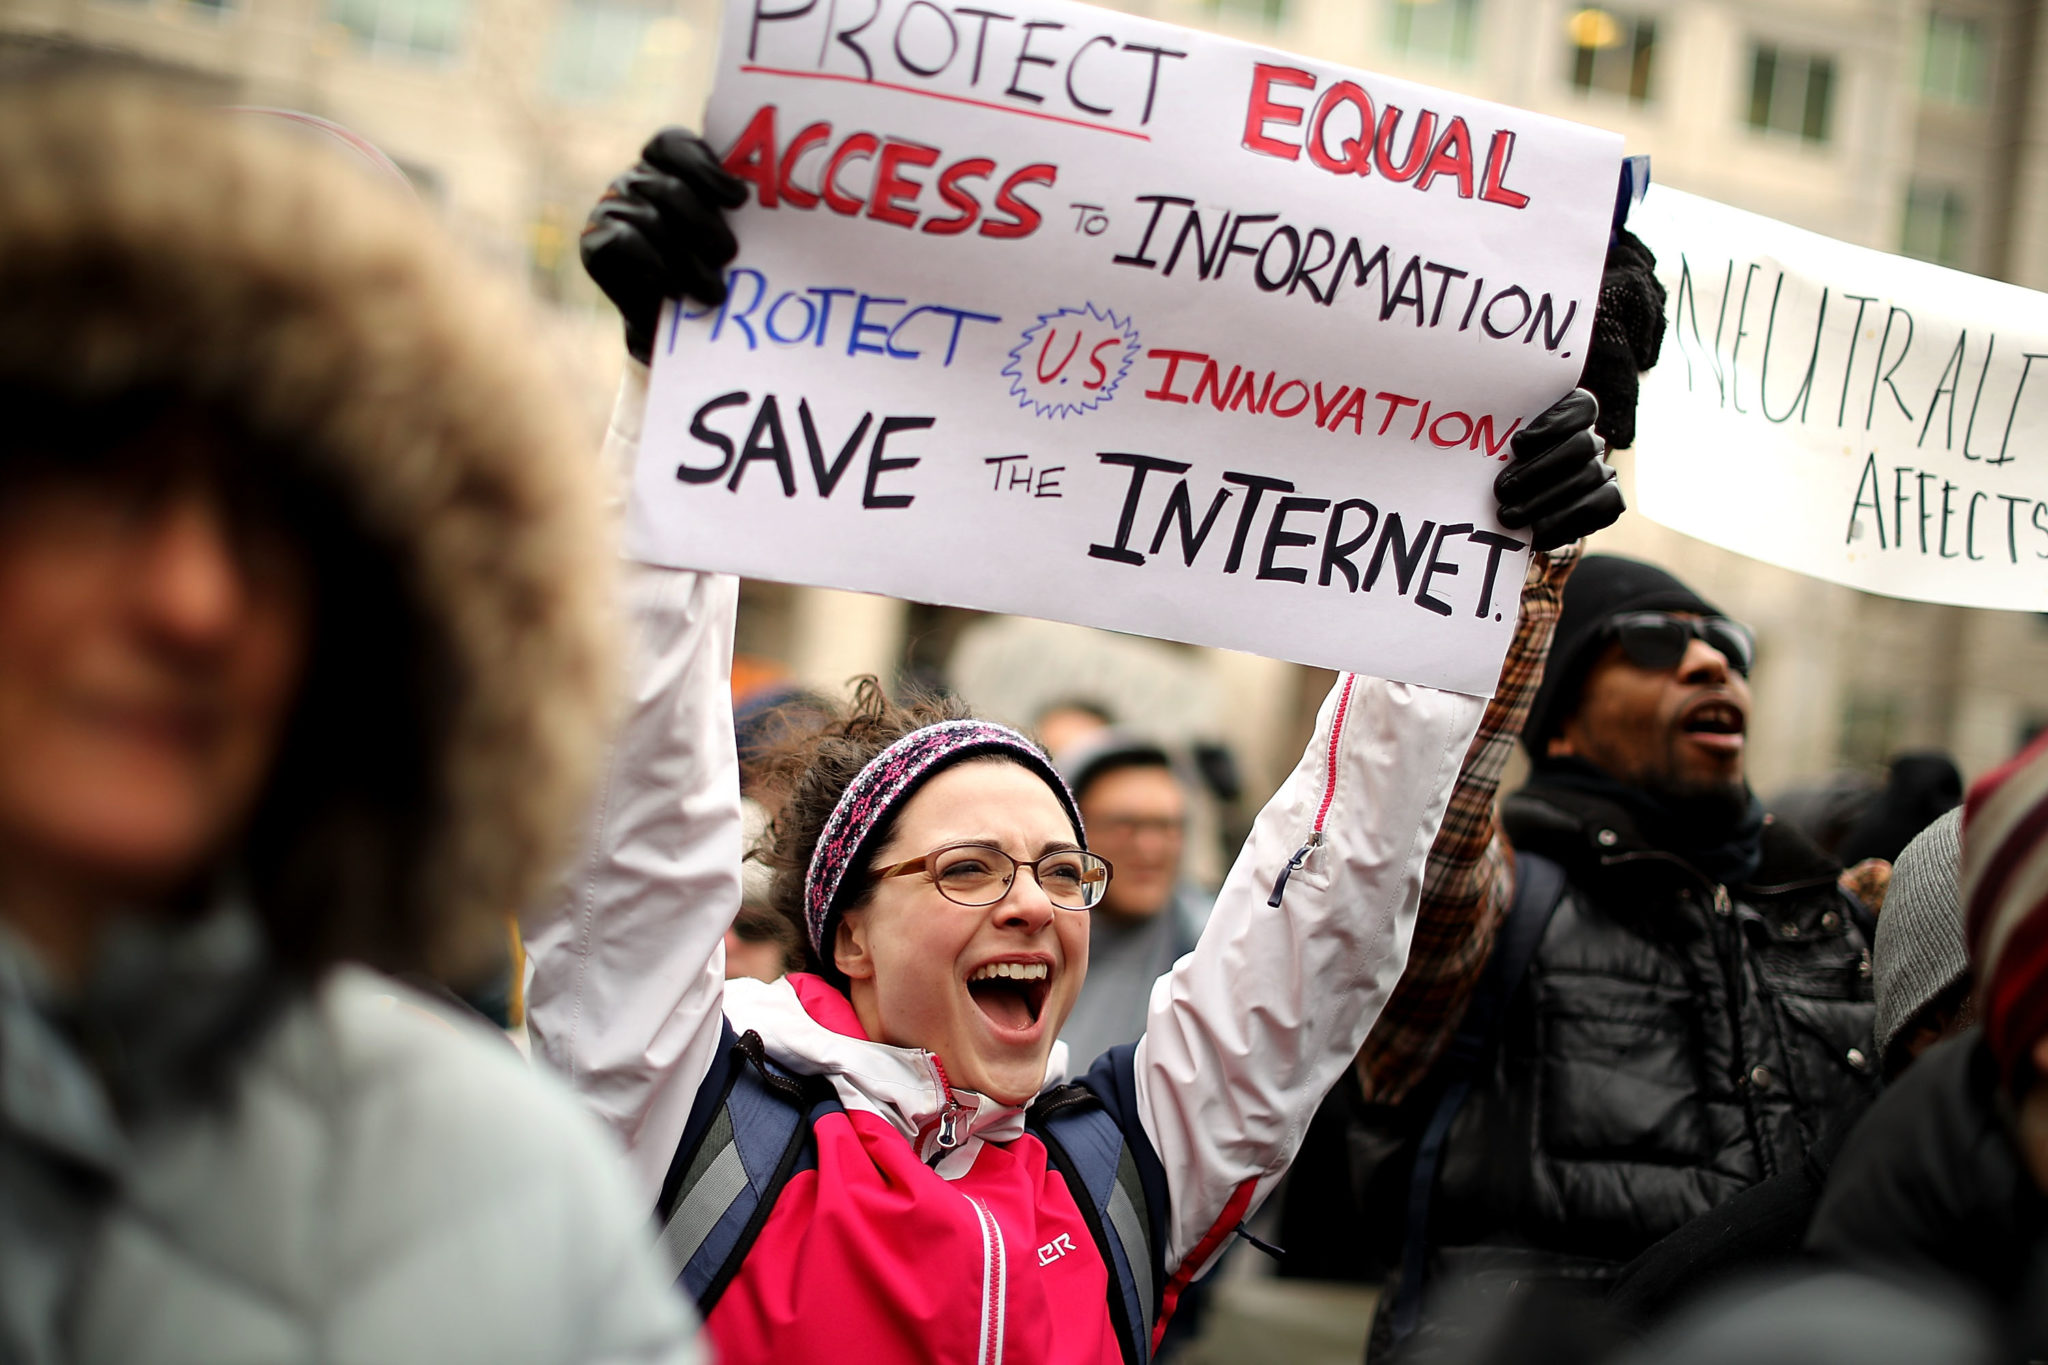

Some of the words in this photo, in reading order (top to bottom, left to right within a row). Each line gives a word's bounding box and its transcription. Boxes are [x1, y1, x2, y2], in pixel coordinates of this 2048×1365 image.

[748, 0, 1187, 125] PROTECT
[1241, 62, 1530, 209] EQUAL
[720, 104, 1058, 240] ACCESS
[1070, 203, 1109, 236] TO
[1112, 195, 1577, 358] INFORMATION.
[1037, 328, 1121, 392] U.S.
[1144, 348, 1522, 461] INNOVATION.
[1676, 252, 2048, 466] NEUTRALI
[676, 391, 936, 509] SAVE
[985, 454, 1065, 498] THE
[1088, 452, 1527, 622] INTERNET.
[1846, 452, 2048, 564] AFFECTS
